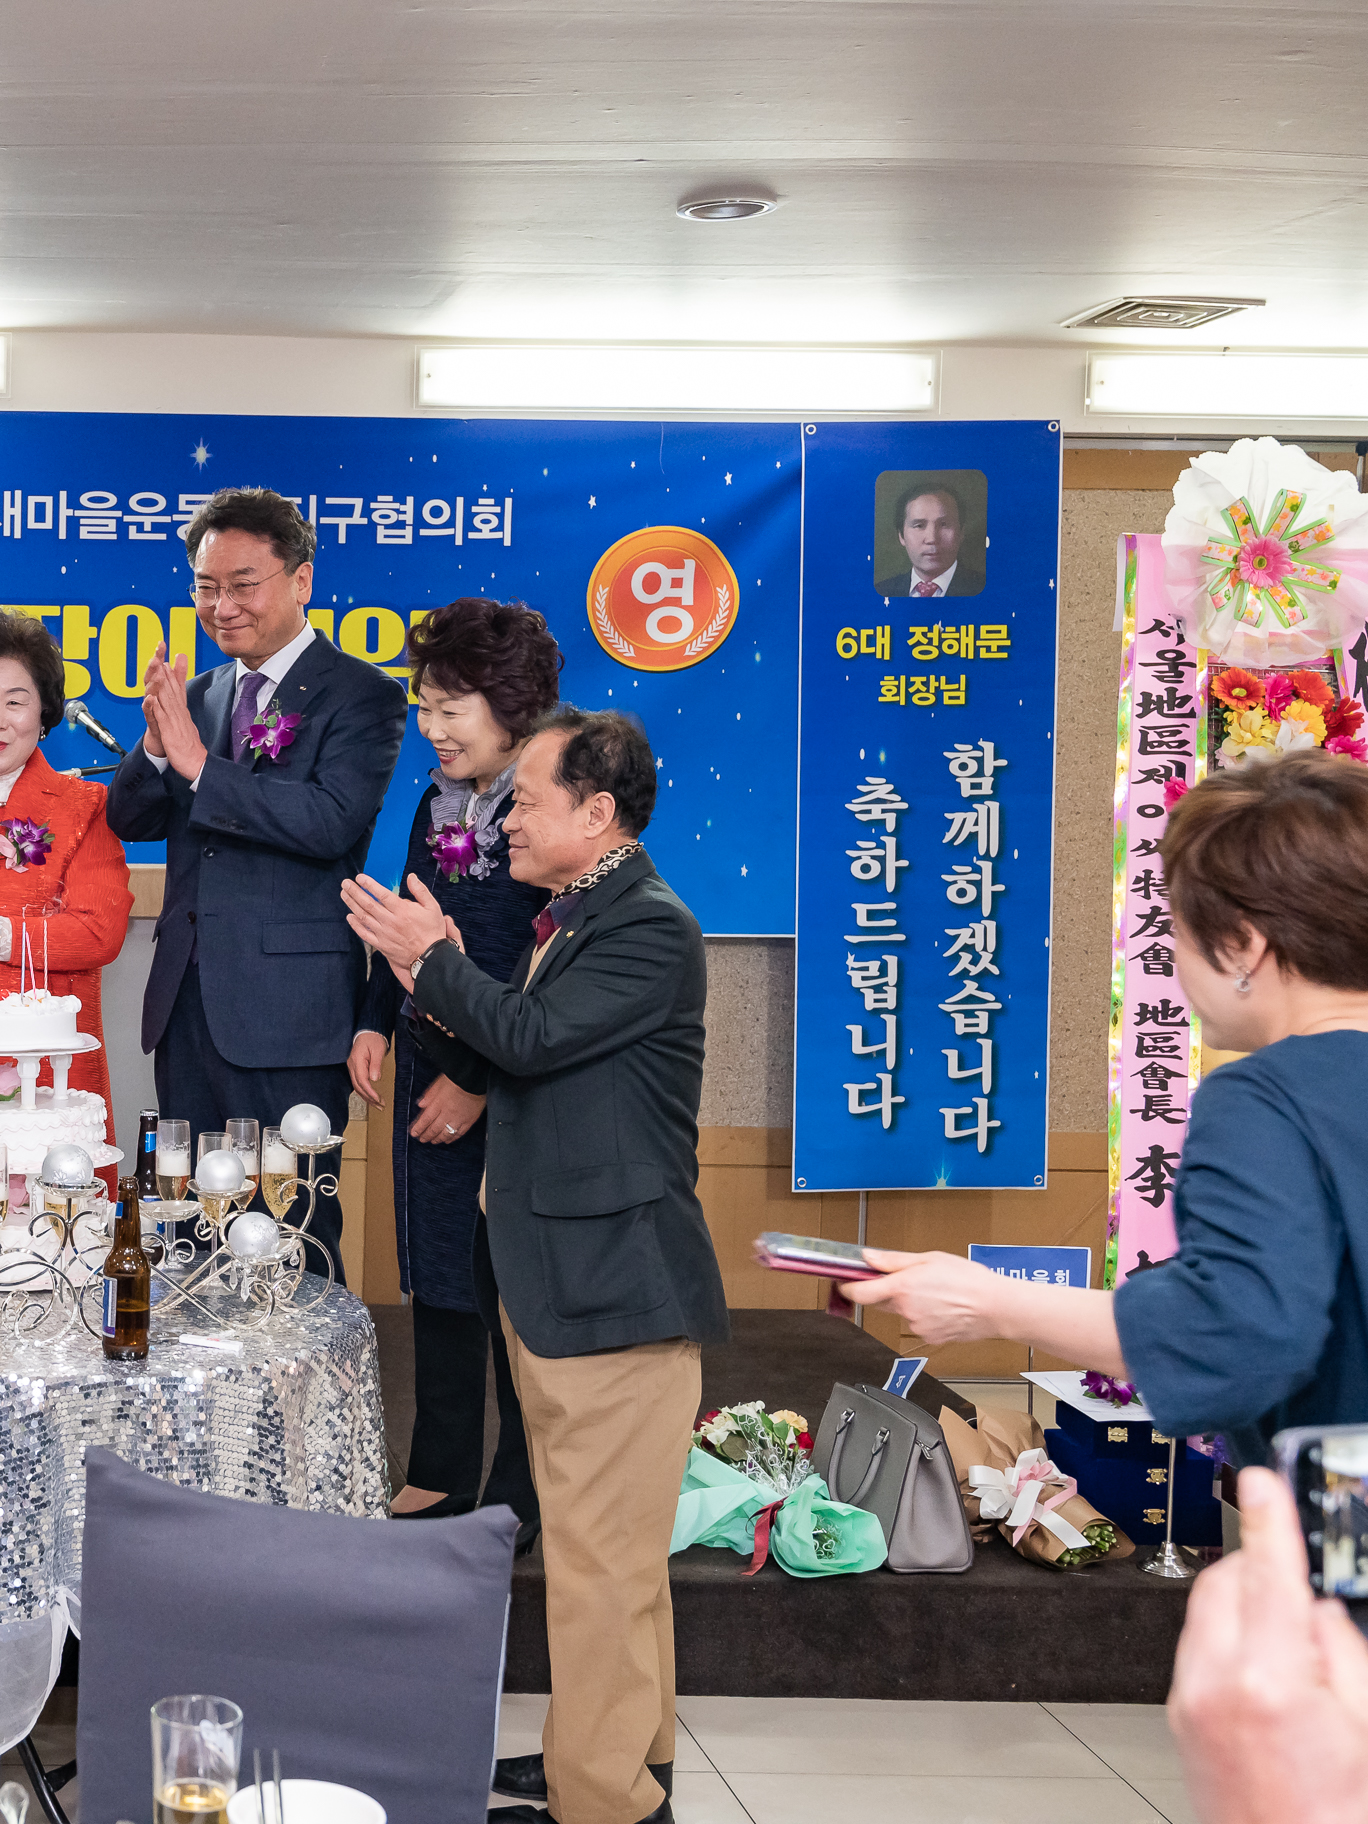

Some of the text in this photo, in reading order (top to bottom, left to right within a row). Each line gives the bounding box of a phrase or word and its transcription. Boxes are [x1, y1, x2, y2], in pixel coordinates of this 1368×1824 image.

[631, 559, 695, 643] 영
[836, 624, 1011, 660] 6대 정해문
[878, 675, 967, 706] 회장님
[843, 777, 909, 1129] 축하드립니다
[938, 740, 1008, 1153] 함께하겠습니다
